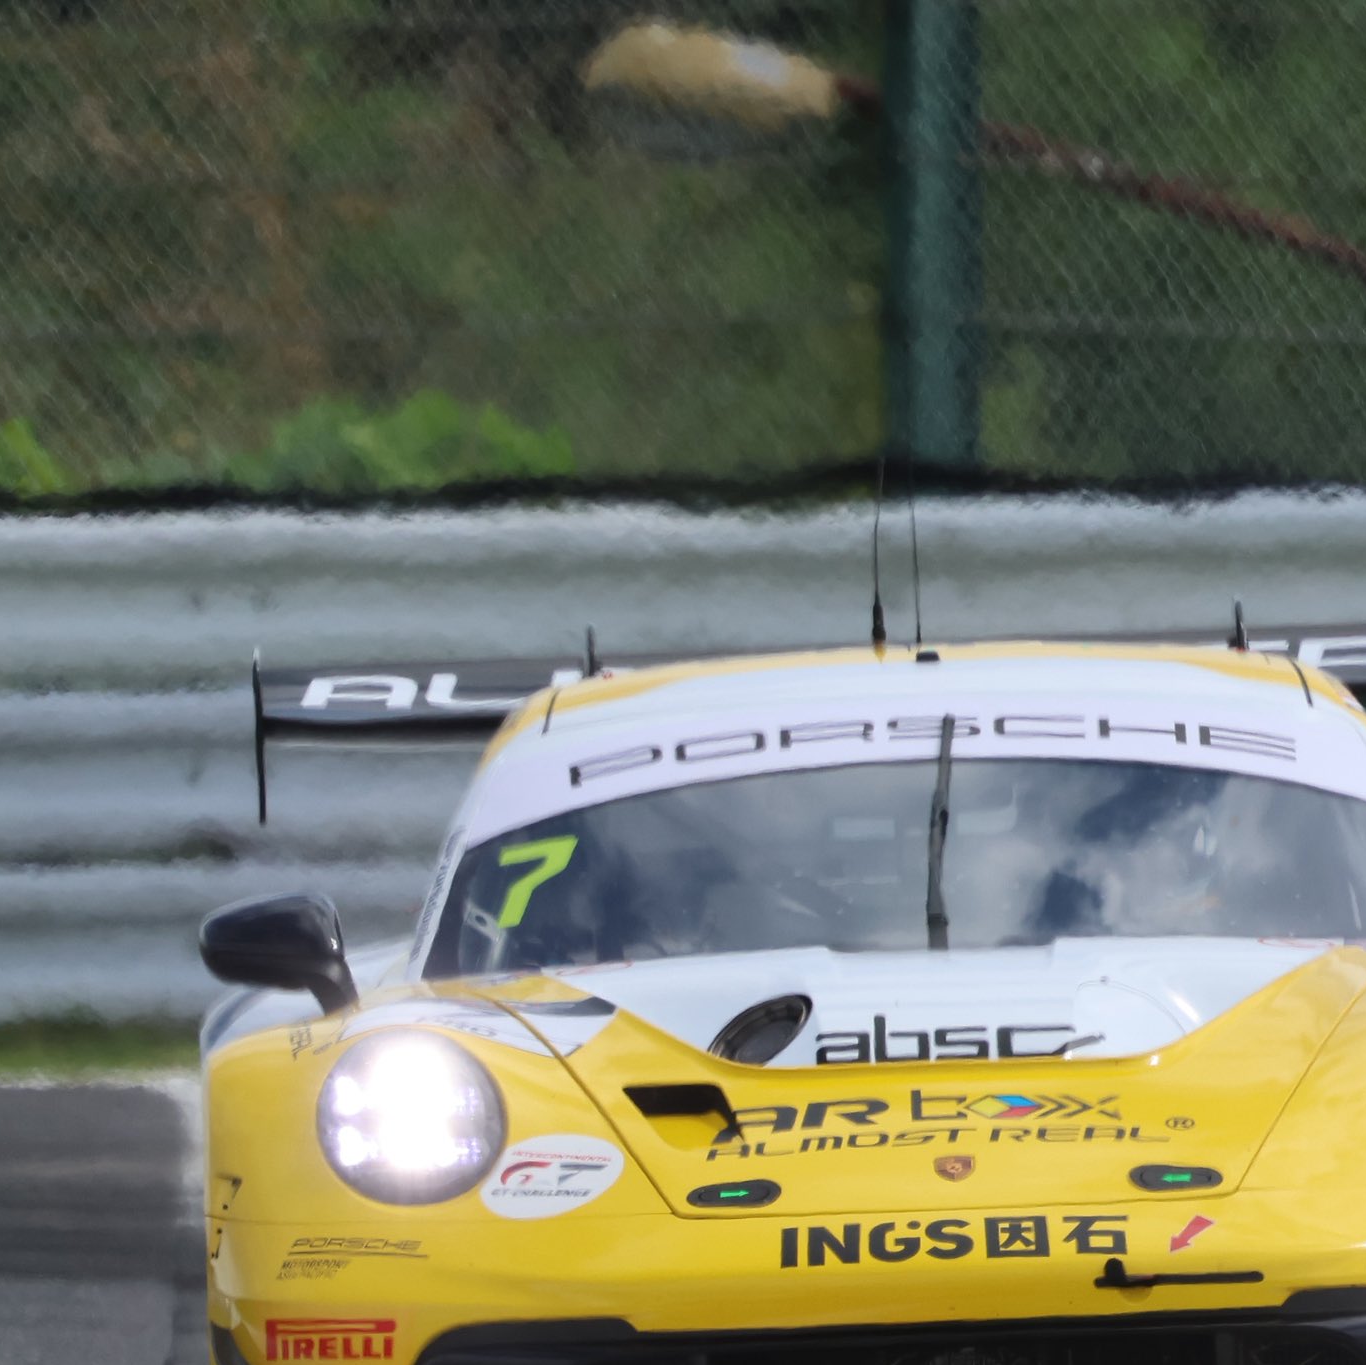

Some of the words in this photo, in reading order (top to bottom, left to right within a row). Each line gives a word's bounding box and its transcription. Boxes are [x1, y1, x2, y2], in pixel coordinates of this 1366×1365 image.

[569, 713, 1296, 787] PORSCHE
[498, 835, 578, 929] 7
[291, 1237, 423, 1251] PORSCHE
[265, 1319, 397, 1361] PIRELLI
